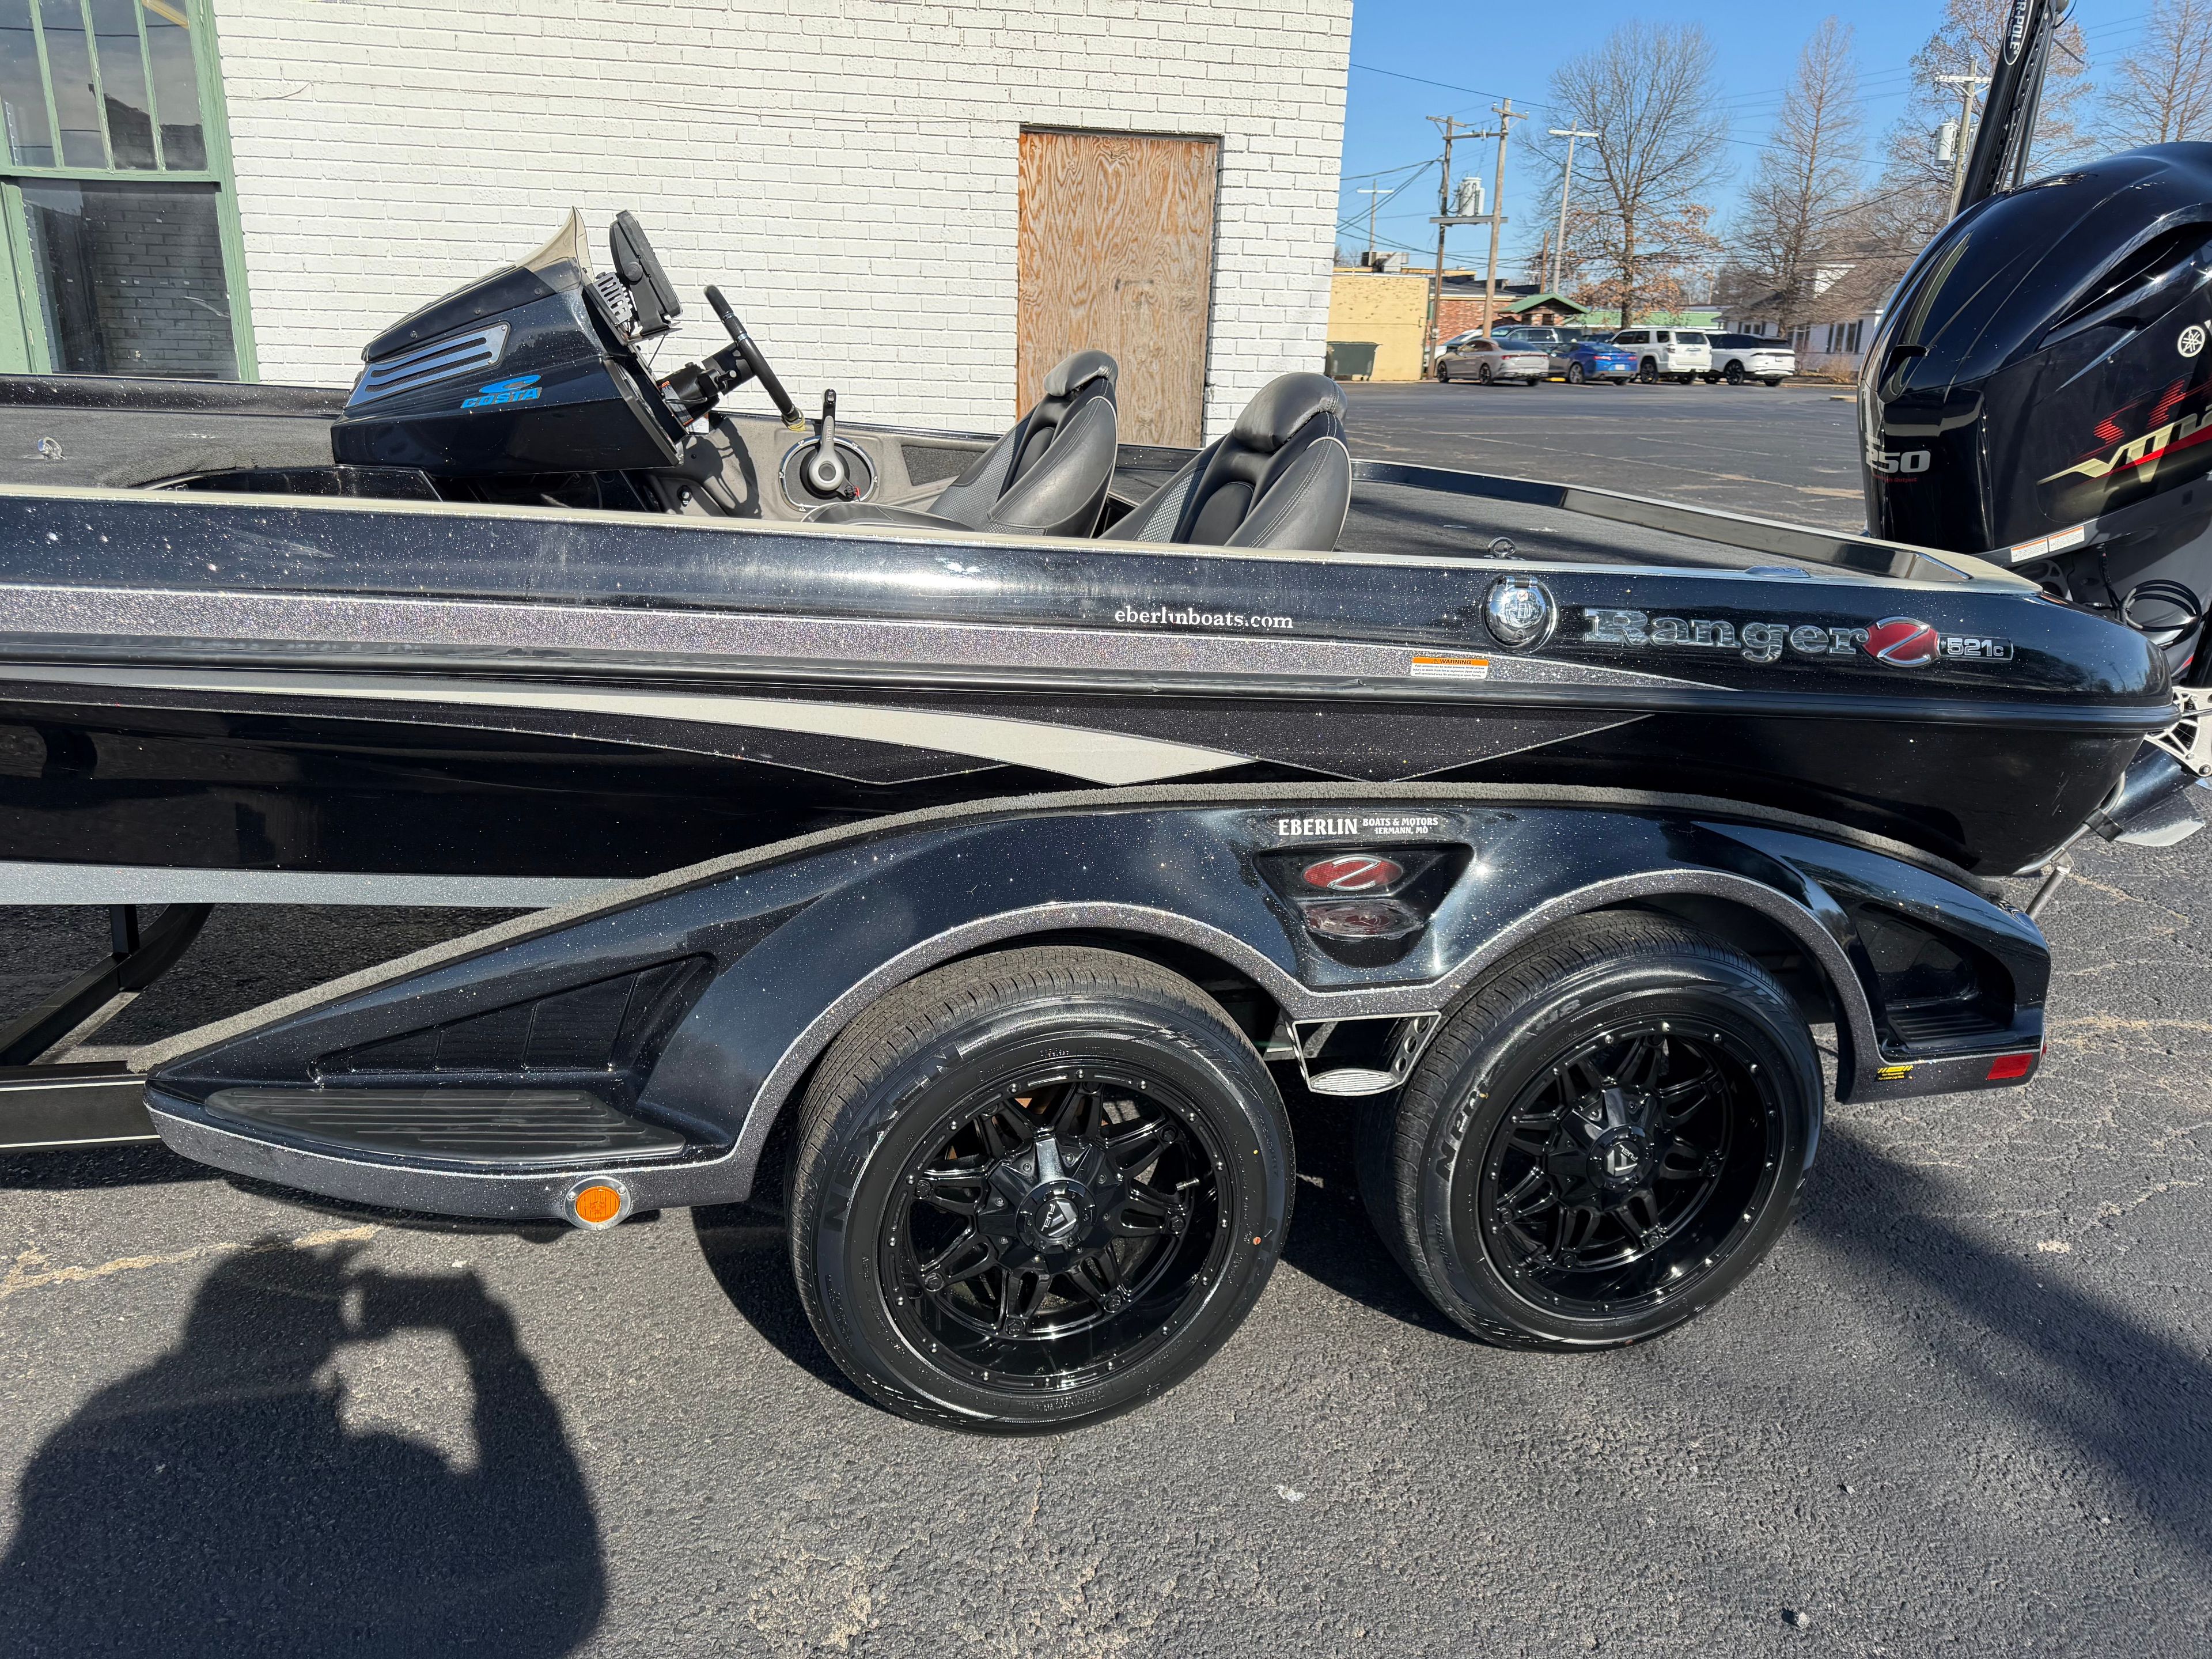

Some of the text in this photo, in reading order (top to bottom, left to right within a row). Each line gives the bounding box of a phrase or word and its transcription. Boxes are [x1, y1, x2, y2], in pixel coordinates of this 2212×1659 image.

[461, 387, 539, 408] COSTA
[1866, 445, 1931, 473] 250
[1115, 605, 1294, 629] eberlinboats.com
[1584, 608, 1870, 663] Ranger
[1278, 817, 1439, 836] EBERLIN BOATS & MOTORS
[1415, 826, 1429, 834] MO
[824, 1041, 964, 1232] NEXEN
[1619, 1144, 1638, 1162] FUEL
[1041, 1203, 1055, 1232] FUEL
